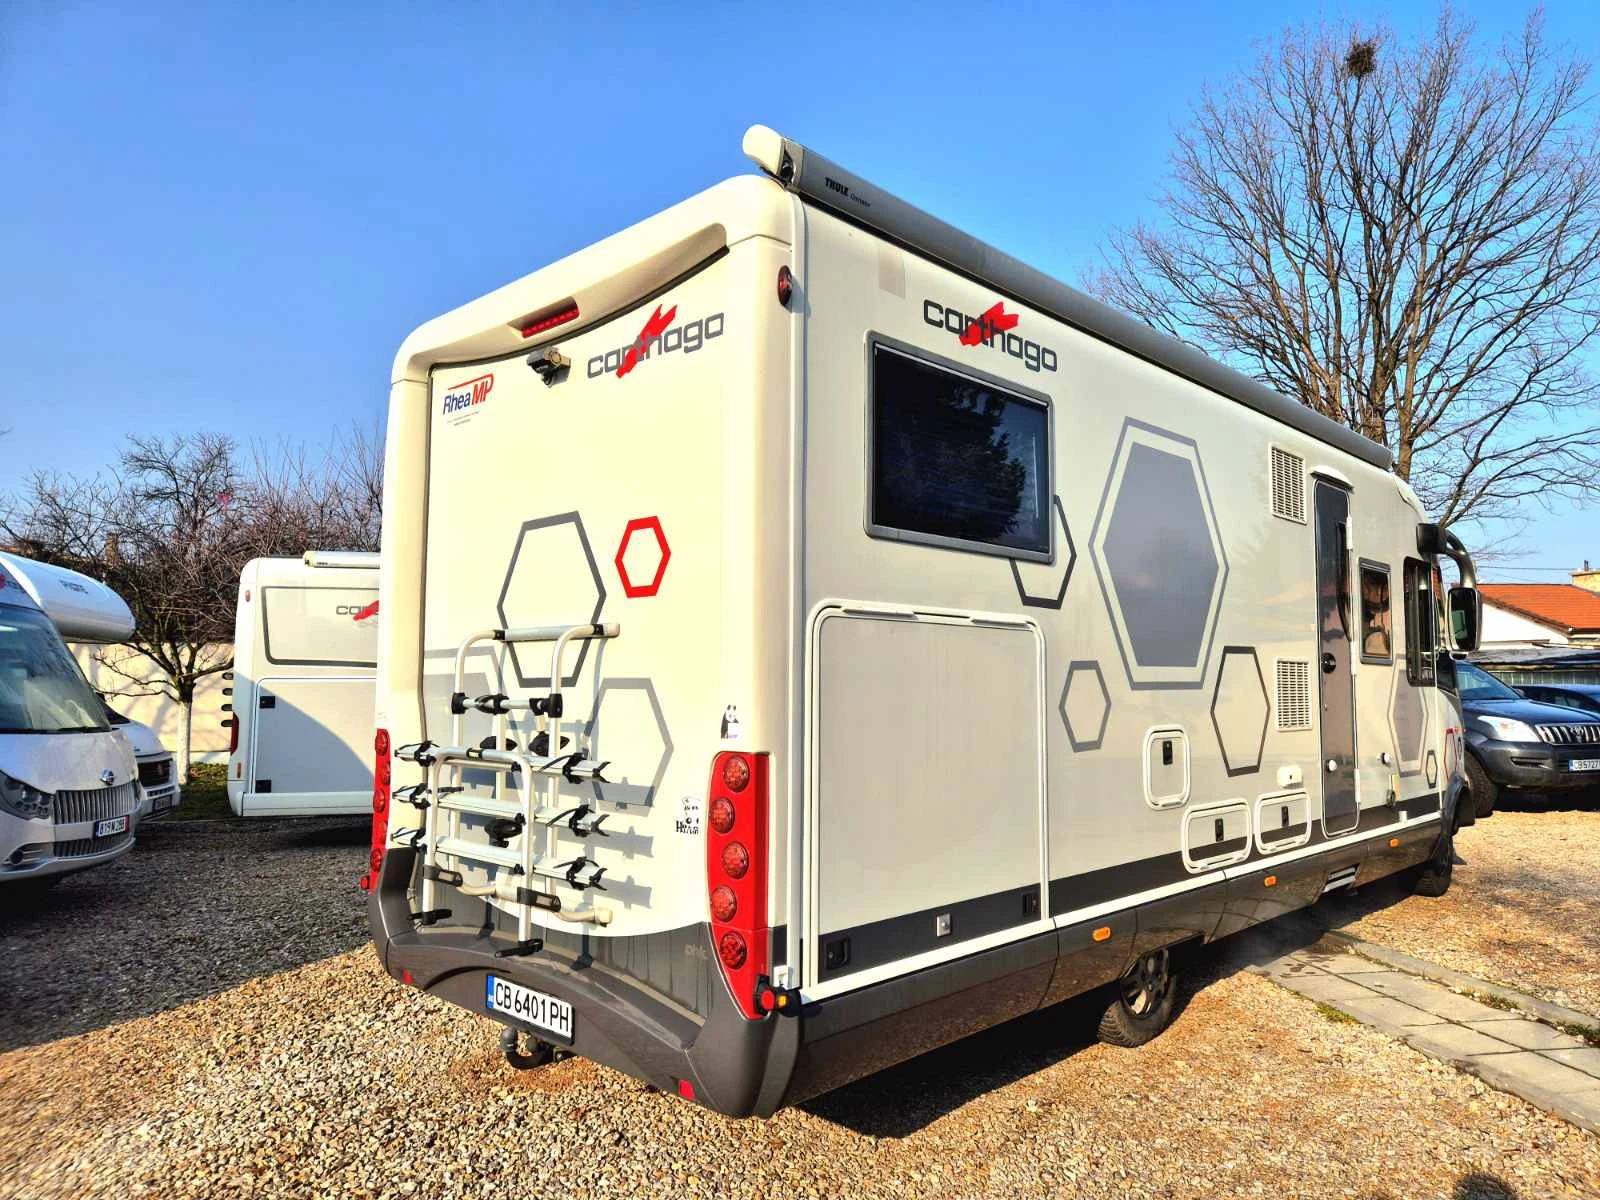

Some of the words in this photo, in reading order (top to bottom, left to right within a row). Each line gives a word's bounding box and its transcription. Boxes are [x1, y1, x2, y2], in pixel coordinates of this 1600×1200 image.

[825, 176, 848, 196] THULE
[587, 312, 725, 379] carthago
[923, 299, 1058, 373] carthago
